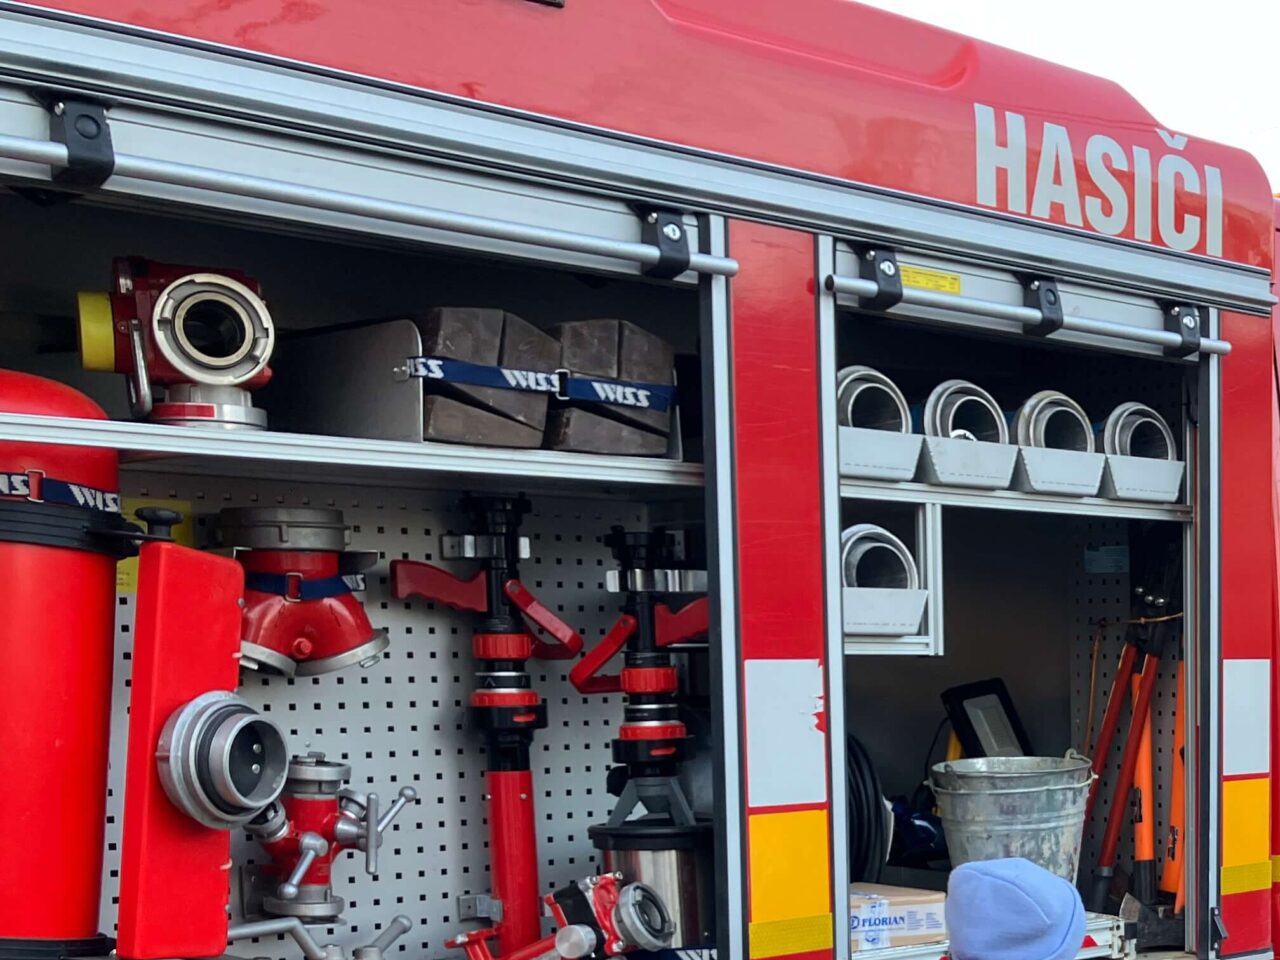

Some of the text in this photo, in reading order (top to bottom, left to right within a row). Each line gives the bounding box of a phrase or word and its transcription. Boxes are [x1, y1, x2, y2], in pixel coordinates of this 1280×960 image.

[974, 102, 1223, 257] HASIČI
[501, 368, 560, 392] WISS
[591, 381, 651, 408] WISS
[67, 483, 120, 513] WIS
[862, 916, 905, 927] FLORIAN
